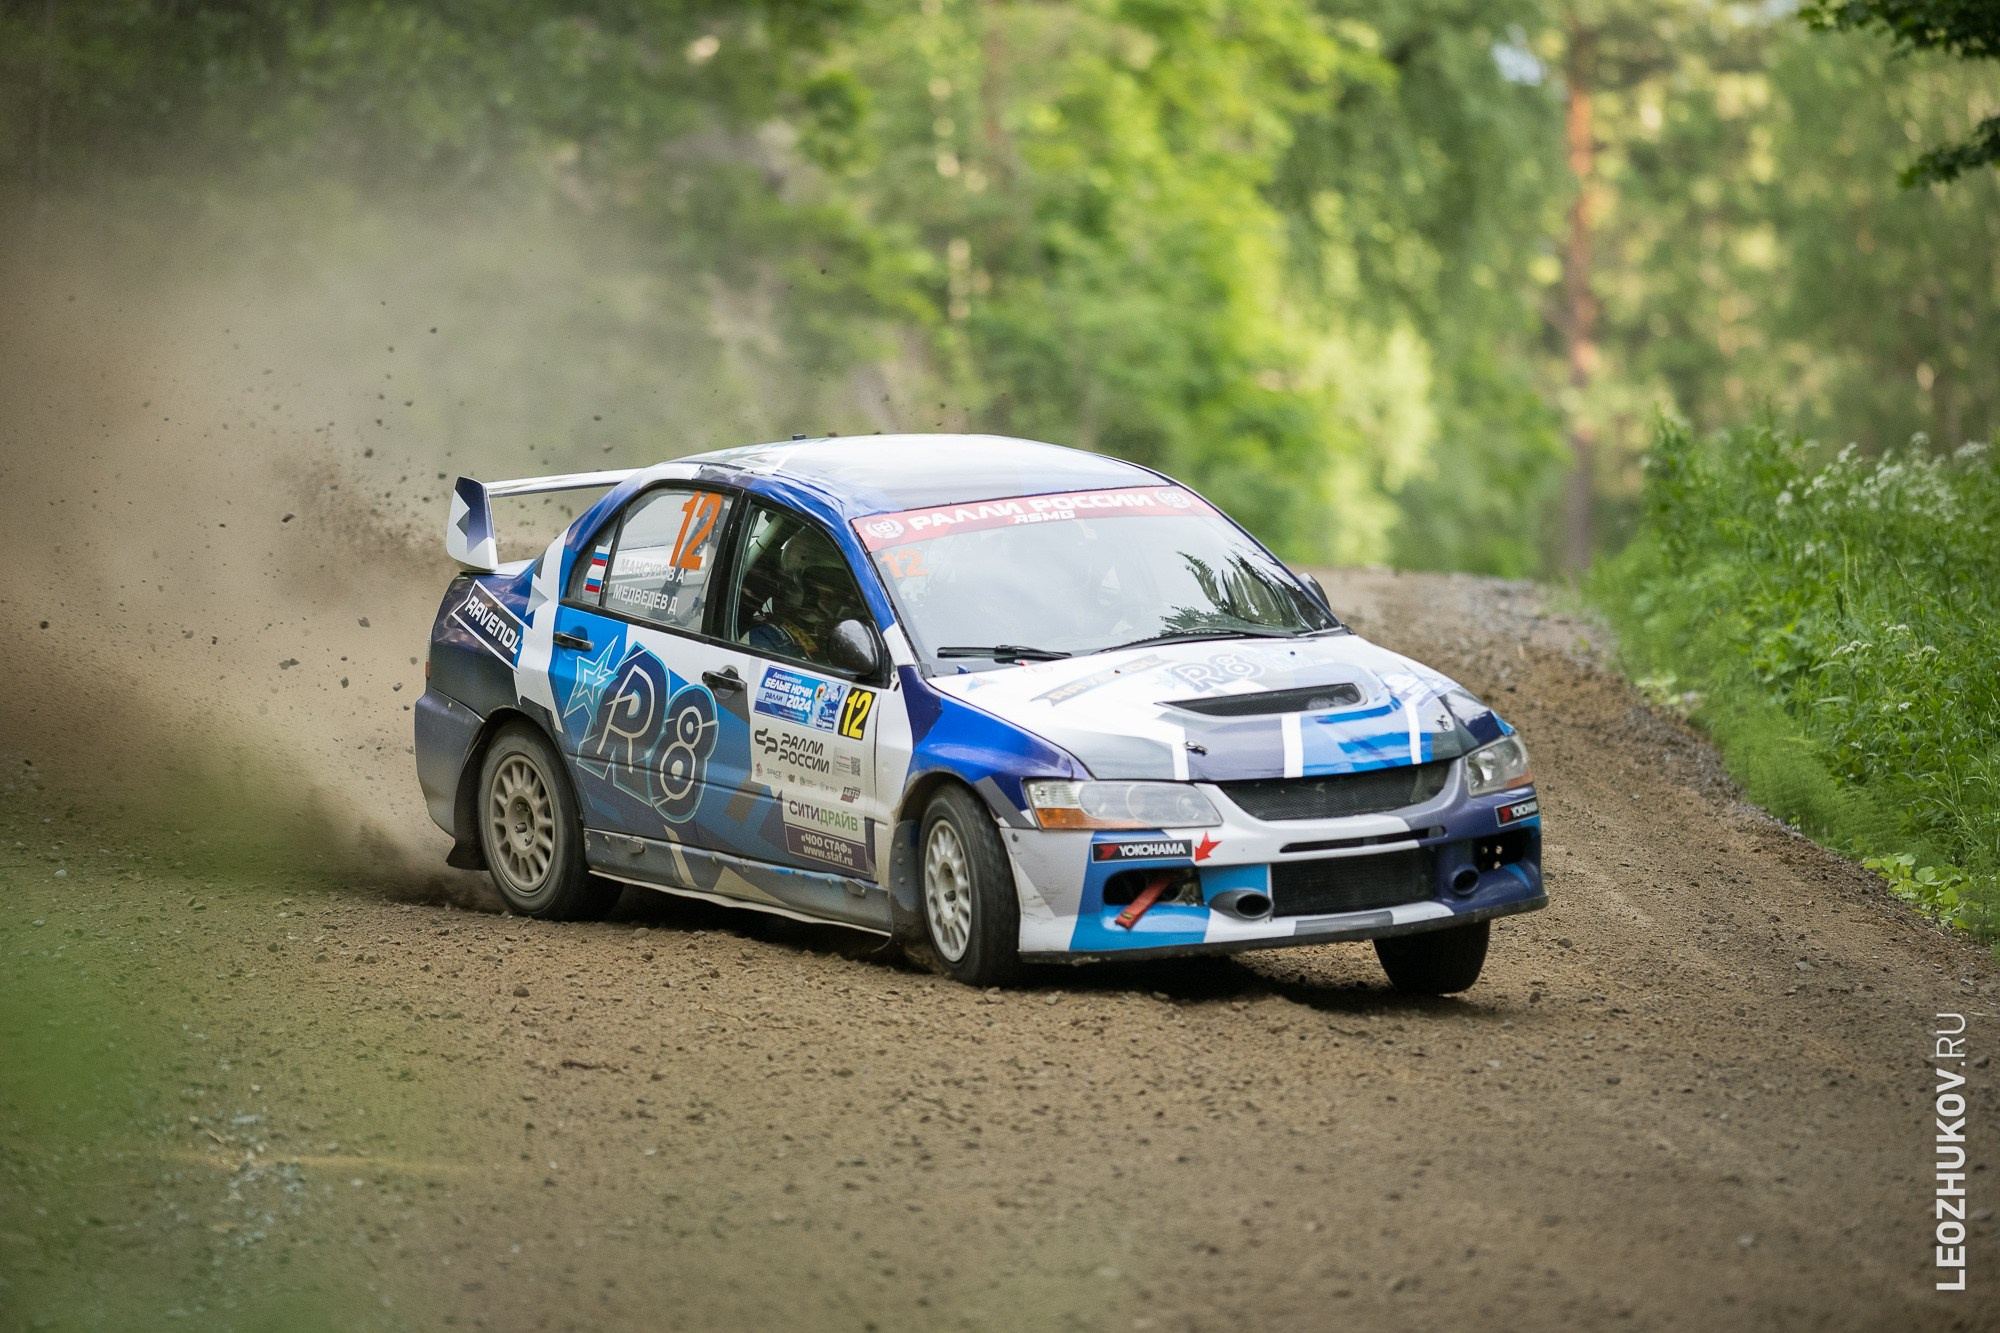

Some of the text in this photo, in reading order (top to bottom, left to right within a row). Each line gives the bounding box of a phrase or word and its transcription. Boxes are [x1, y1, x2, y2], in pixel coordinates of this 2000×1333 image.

[910, 502, 1023, 530] РАЛЛИ
[1030, 493, 1156, 512] РОССИИ
[669, 490, 722, 571] 12
[676, 570, 685, 583] А
[880, 548, 928, 579] 12
[613, 584, 678, 615] МЕДВЕДЕВ Д
[465, 595, 520, 654] RAVENOL
[765, 677, 813, 698] БЕЛЫЕ НОЧИ
[1047, 657, 1163, 699] RAVOL
[1169, 653, 1265, 692] R8
[764, 692, 783, 701] ралли
[786, 694, 812, 712] 2024
[842, 690, 872, 739] 12
[577, 641, 719, 823] R8
[781, 733, 824, 757] РАЛЛИ
[779, 750, 830, 774] РОССИИ
[789, 800, 859, 832] СИТИДРАЙВ
[803, 845, 853, 866] www.staf.ru
[824, 839, 852, 854] СТАФ»
[1119, 843, 1186, 856] YOKOHAMA
